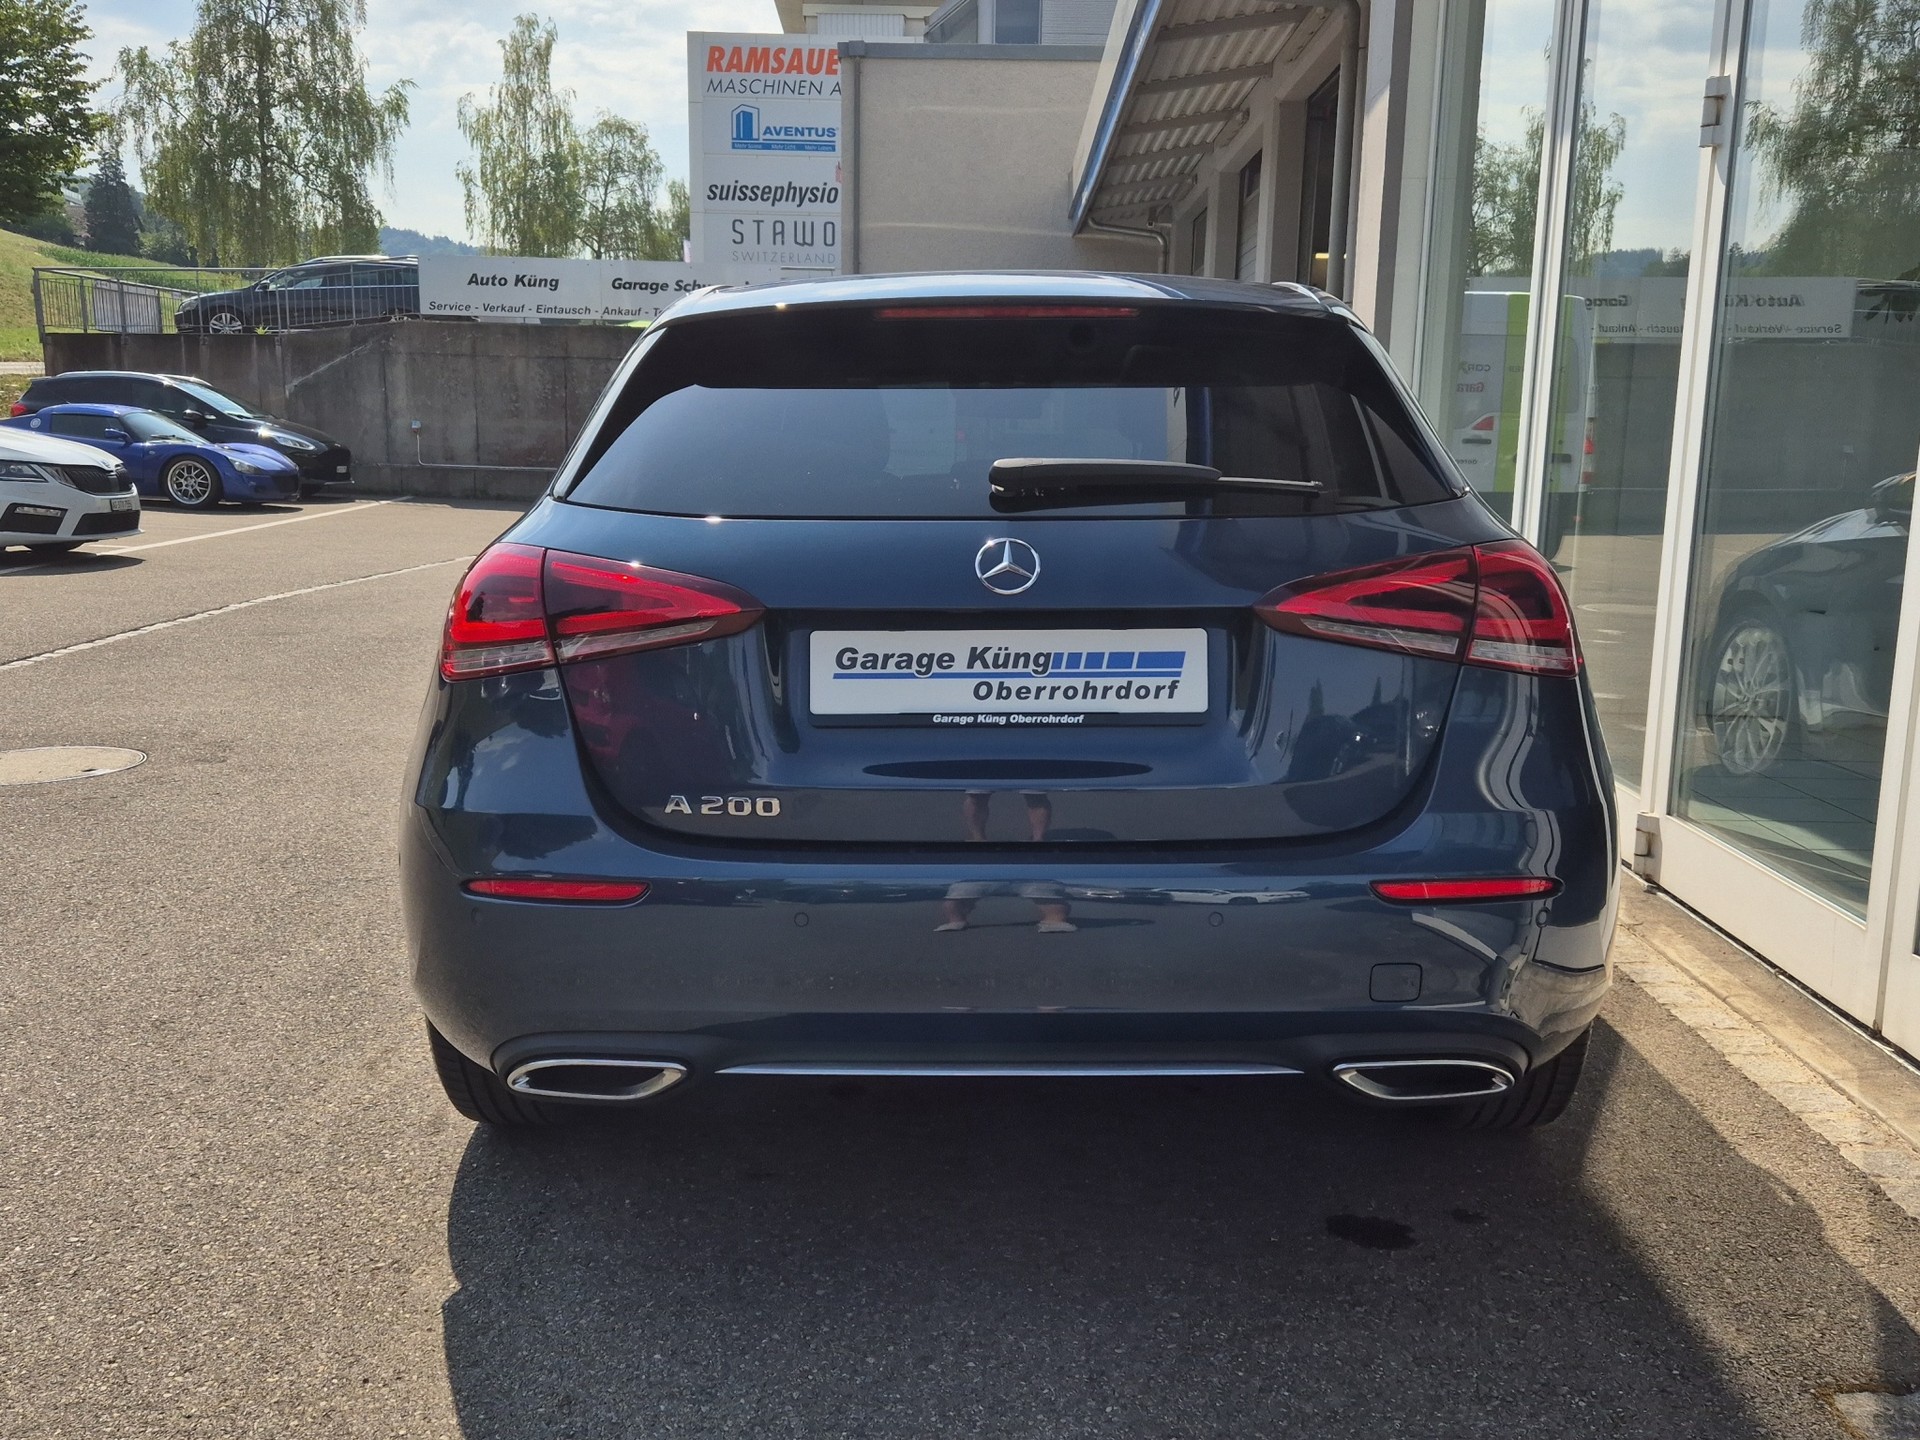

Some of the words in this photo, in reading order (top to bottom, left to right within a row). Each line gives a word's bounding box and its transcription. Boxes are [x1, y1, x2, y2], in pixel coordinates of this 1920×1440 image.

[706, 46, 839, 76] RAMSAUE
[706, 78, 823, 96] MASCHINEN
[830, 81, 842, 96] A
[762, 126, 836, 138] AVENTUS
[706, 180, 839, 208] suissephysio
[732, 219, 836, 247] STAWO
[732, 250, 836, 264] SWITZERLAND
[467, 273, 508, 287] Auto
[514, 274, 560, 292] Küng
[611, 278, 669, 294] Garage
[428, 301, 472, 312] Service
[482, 302, 526, 313] Verkauf
[536, 304, 591, 315] Eintausch
[602, 306, 642, 316] Ankauf
[835, 647, 955, 676] Garage
[966, 646, 1052, 676] Küng
[972, 680, 1180, 701] Oberrohrdorf
[932, 714, 974, 725] Garage
[977, 714, 1006, 725] Küng
[1009, 714, 1085, 724] Oberrohrdorf
[664, 795, 692, 814] A
[700, 796, 781, 817] 200
